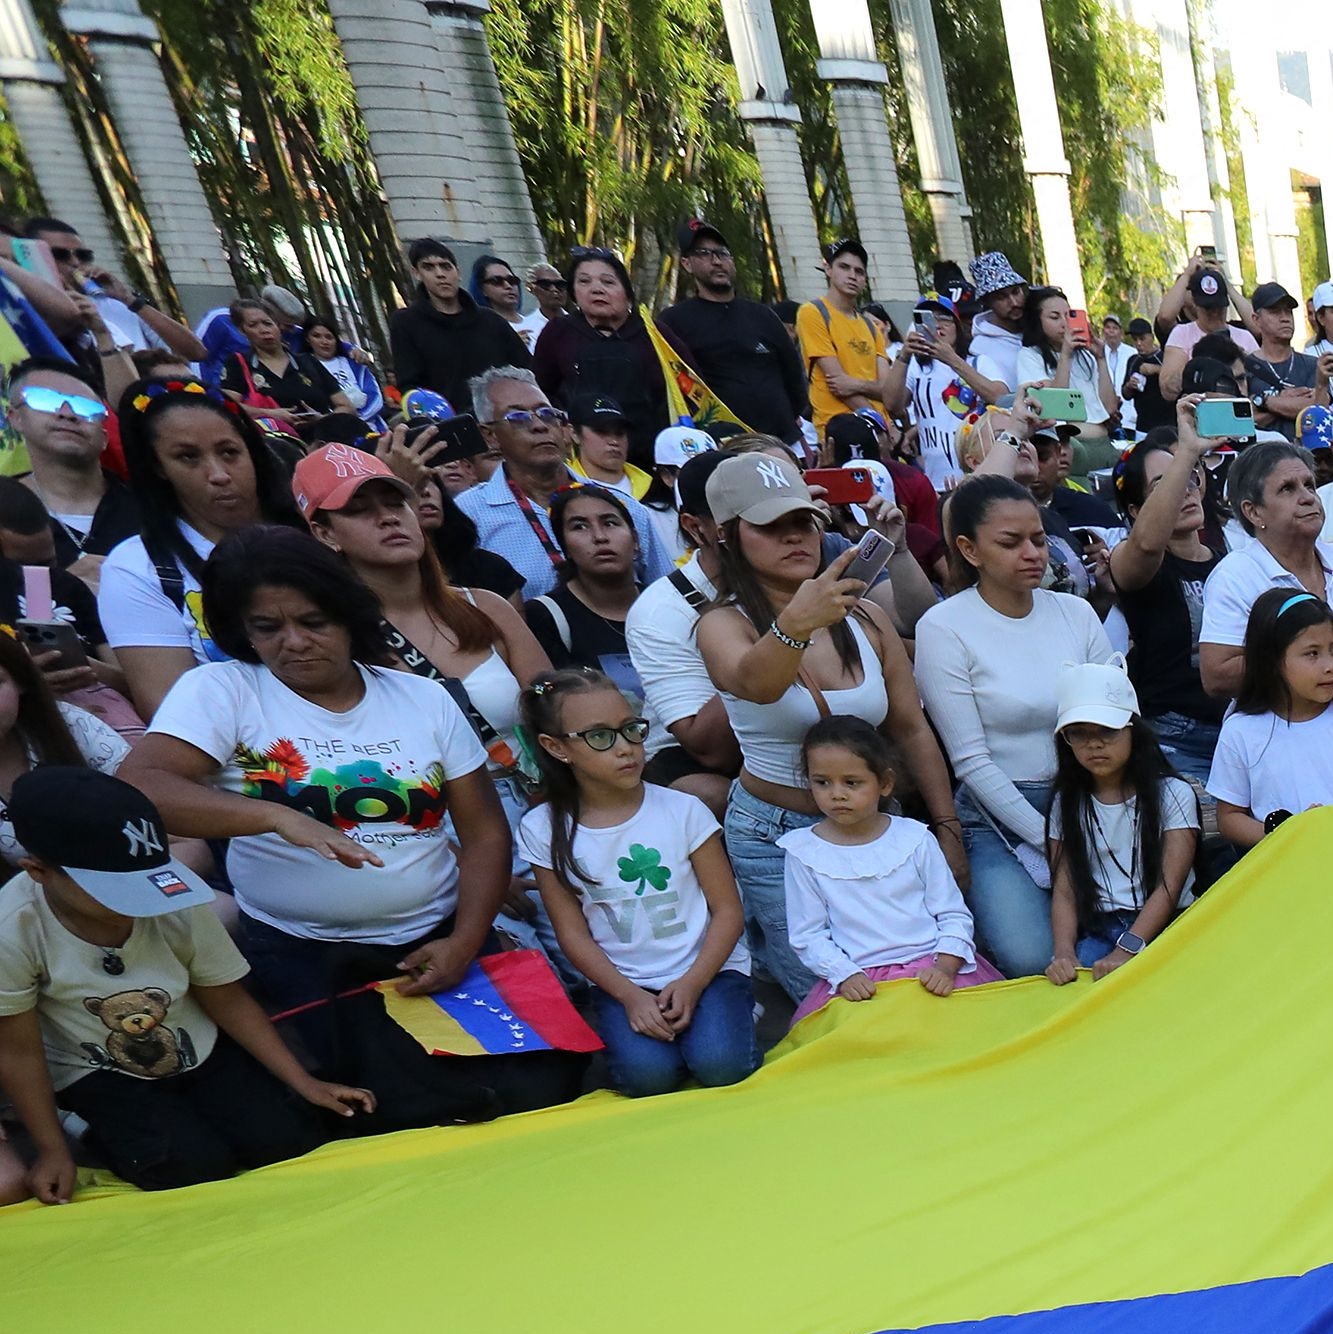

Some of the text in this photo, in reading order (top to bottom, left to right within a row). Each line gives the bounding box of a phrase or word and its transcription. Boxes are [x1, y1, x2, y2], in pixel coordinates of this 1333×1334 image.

[325, 442, 377, 478] NY
[756, 460, 791, 489] NY
[386, 632, 446, 683] ARC
[298, 737, 346, 754] THE
[122, 817, 164, 857] NY
